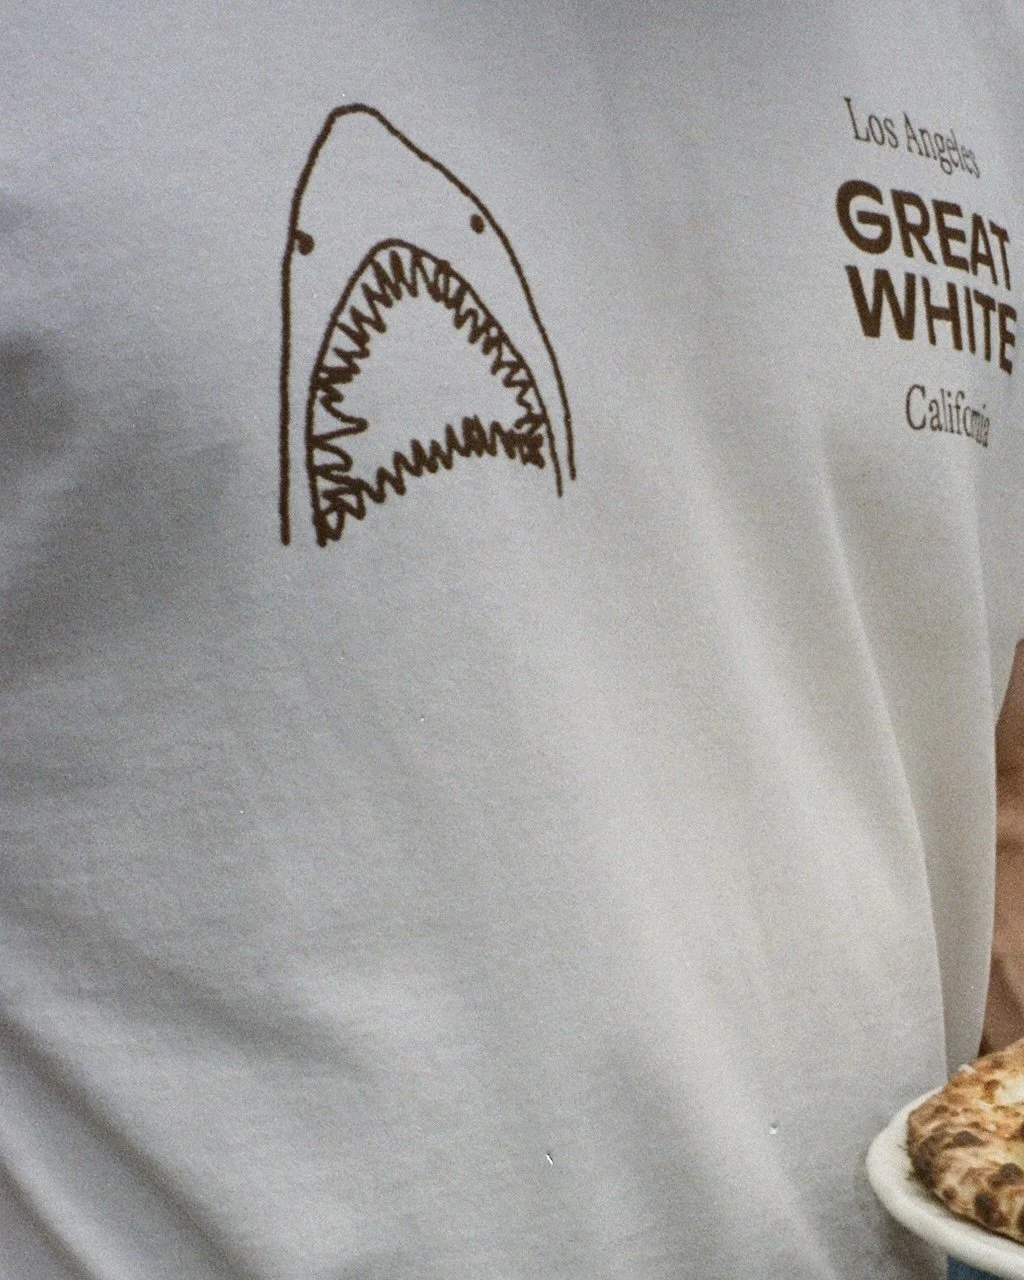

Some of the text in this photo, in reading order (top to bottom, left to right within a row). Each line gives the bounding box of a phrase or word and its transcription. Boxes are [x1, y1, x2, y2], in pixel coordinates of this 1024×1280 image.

[844, 97, 980, 178] Los Angeles
[836, 180, 1011, 290] GREAT
[845, 265, 1018, 374] WHITE
